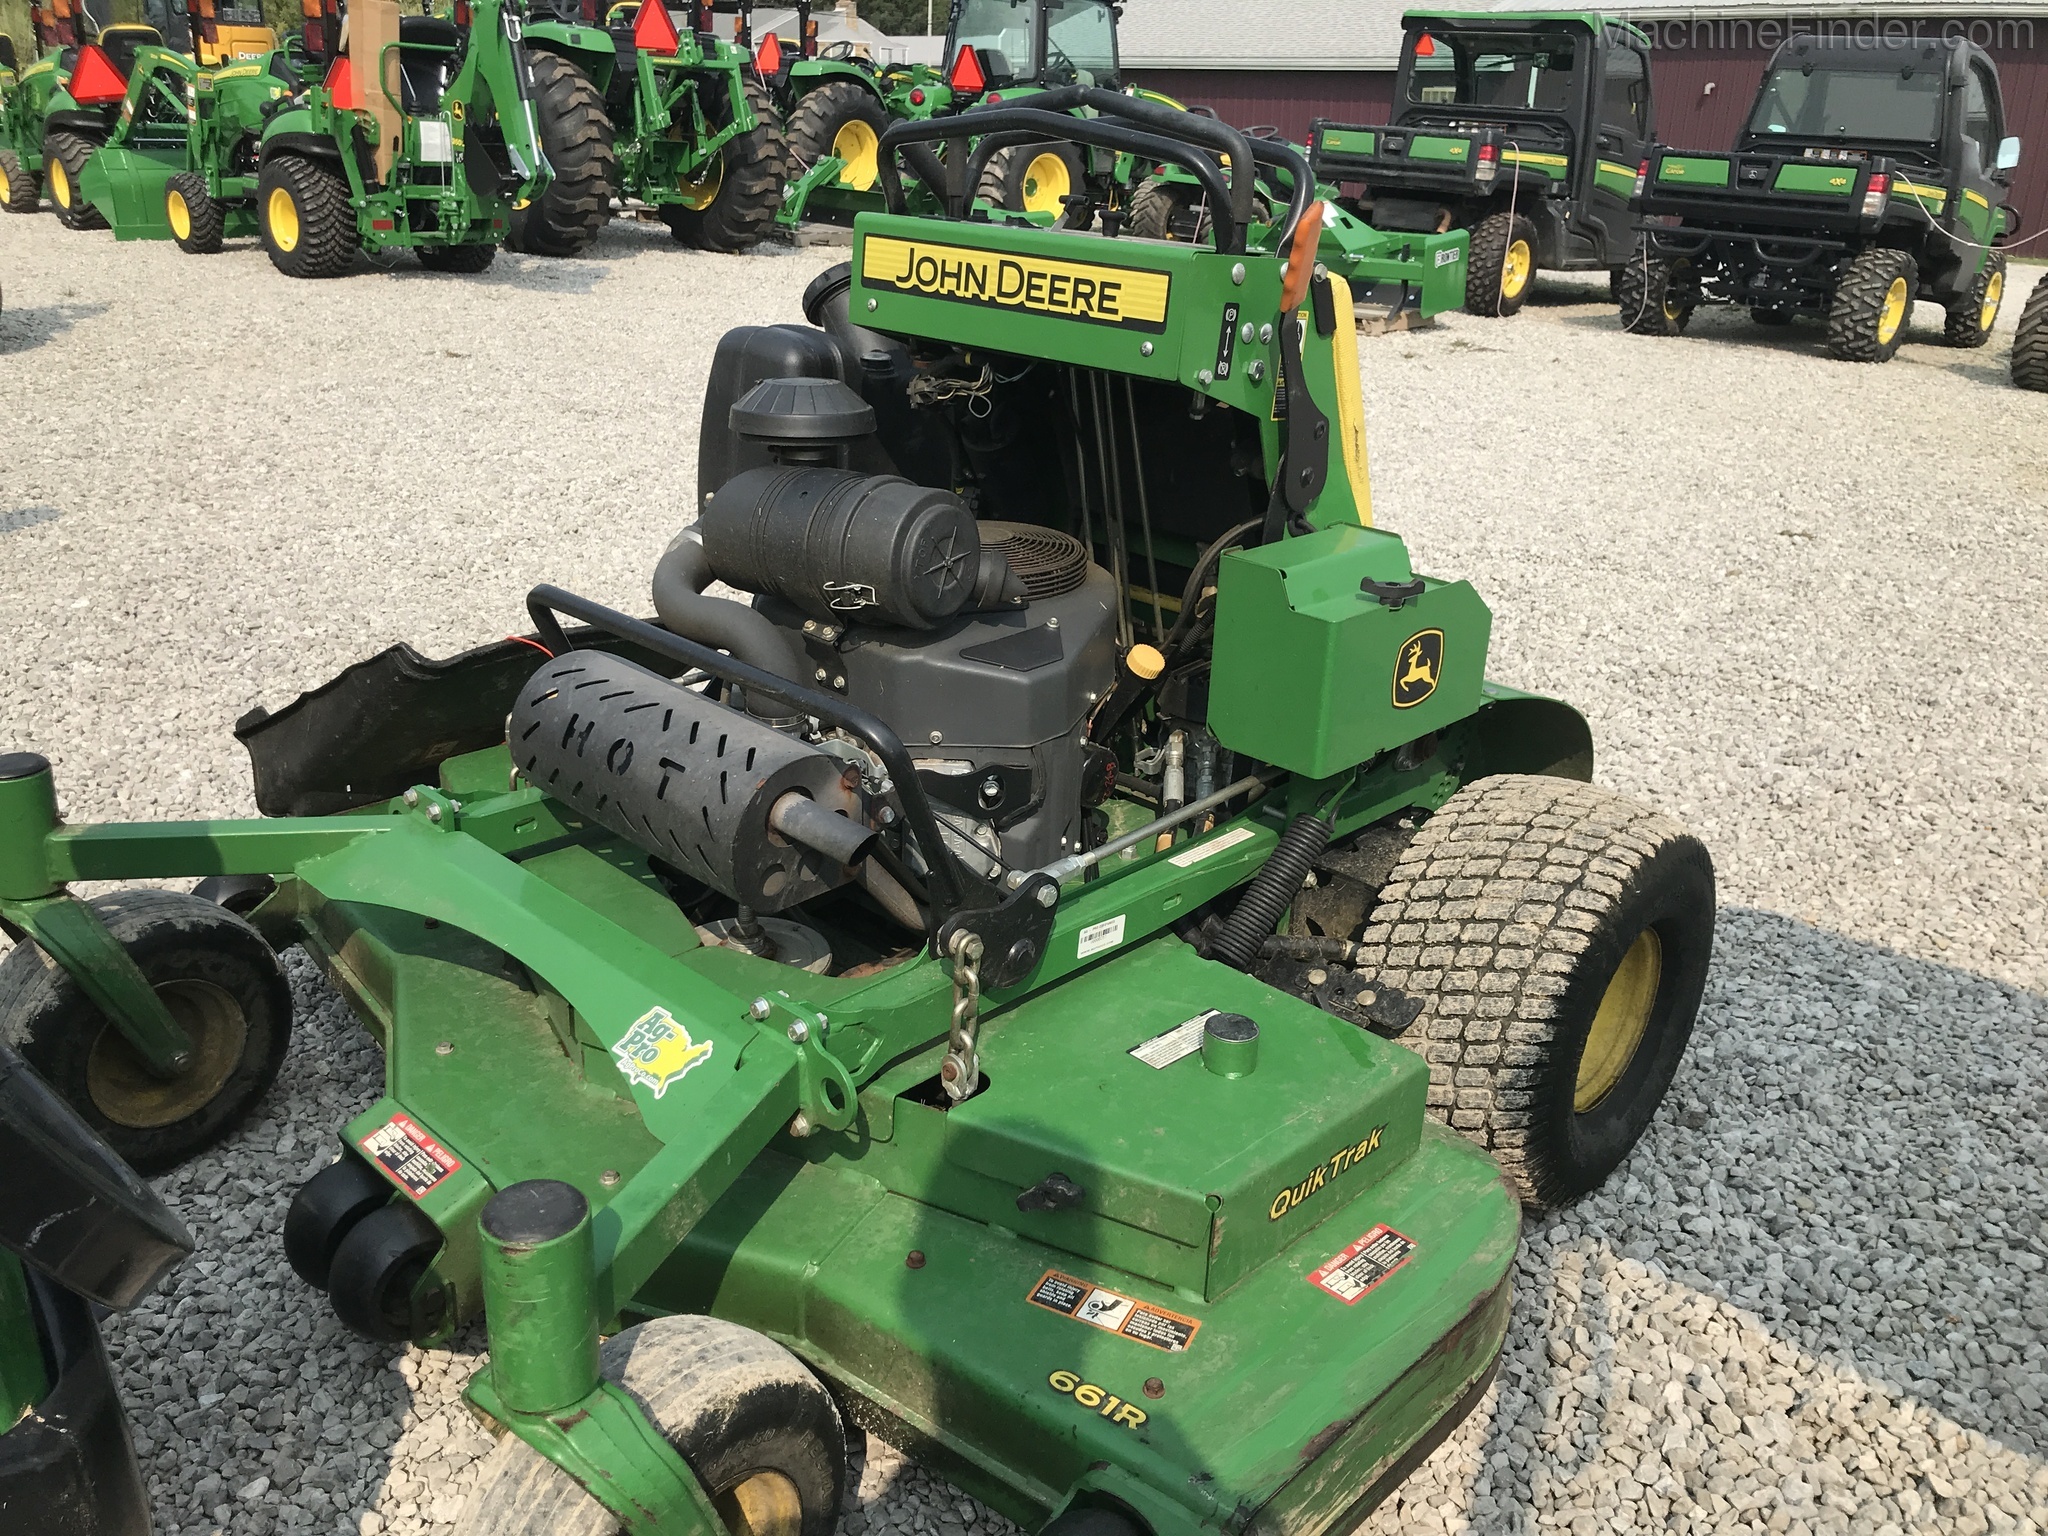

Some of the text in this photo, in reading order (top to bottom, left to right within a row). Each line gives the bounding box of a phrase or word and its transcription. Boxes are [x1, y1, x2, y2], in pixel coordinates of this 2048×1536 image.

[238, 51, 265, 60] DEER
[896, 247, 1122, 315] JOHN DEERE
[561, 712, 687, 801] HOT
[636, 1011, 676, 1042] Ag-
[618, 1029, 660, 1063] Pro
[404, 1123, 426, 1142] DANGER
[432, 1147, 456, 1168] PELIGRO
[1358, 1227, 1384, 1246] PELIGRO
[1323, 1252, 1350, 1272] DANGER
[1151, 1307, 1193, 1325] ADVERTENCIA
[1049, 1370, 1148, 1430] 661R
